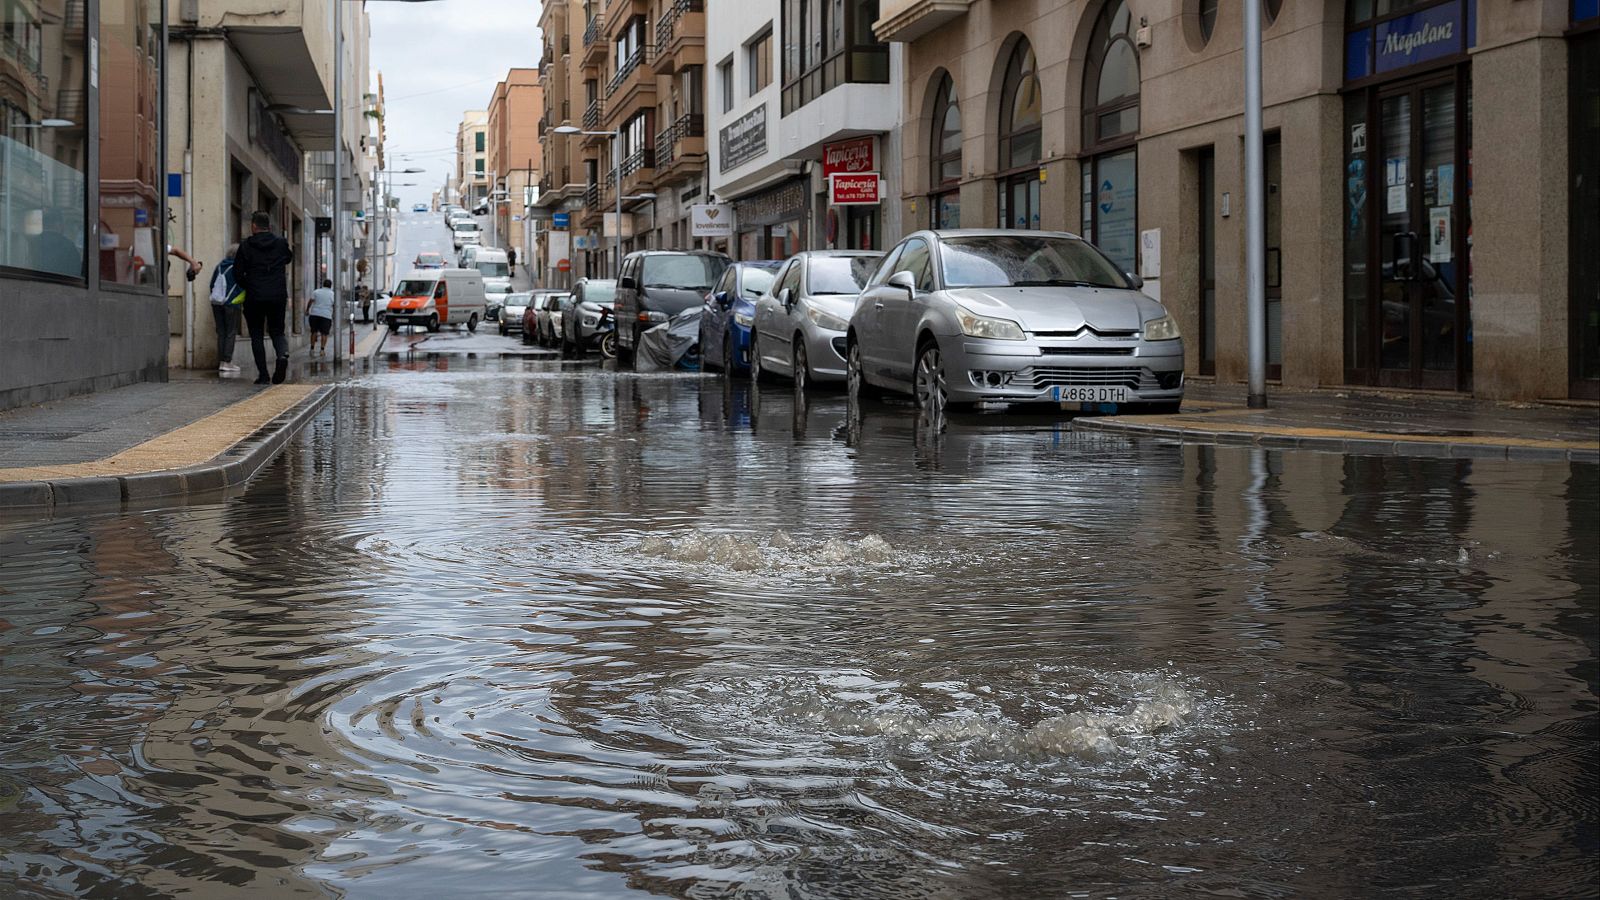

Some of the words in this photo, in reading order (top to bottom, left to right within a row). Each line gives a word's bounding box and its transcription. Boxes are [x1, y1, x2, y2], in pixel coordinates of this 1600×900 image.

[1382, 22, 1453, 55] Megalanz
[1062, 388, 1095, 401] 4863
[1099, 388, 1125, 401] DTH
